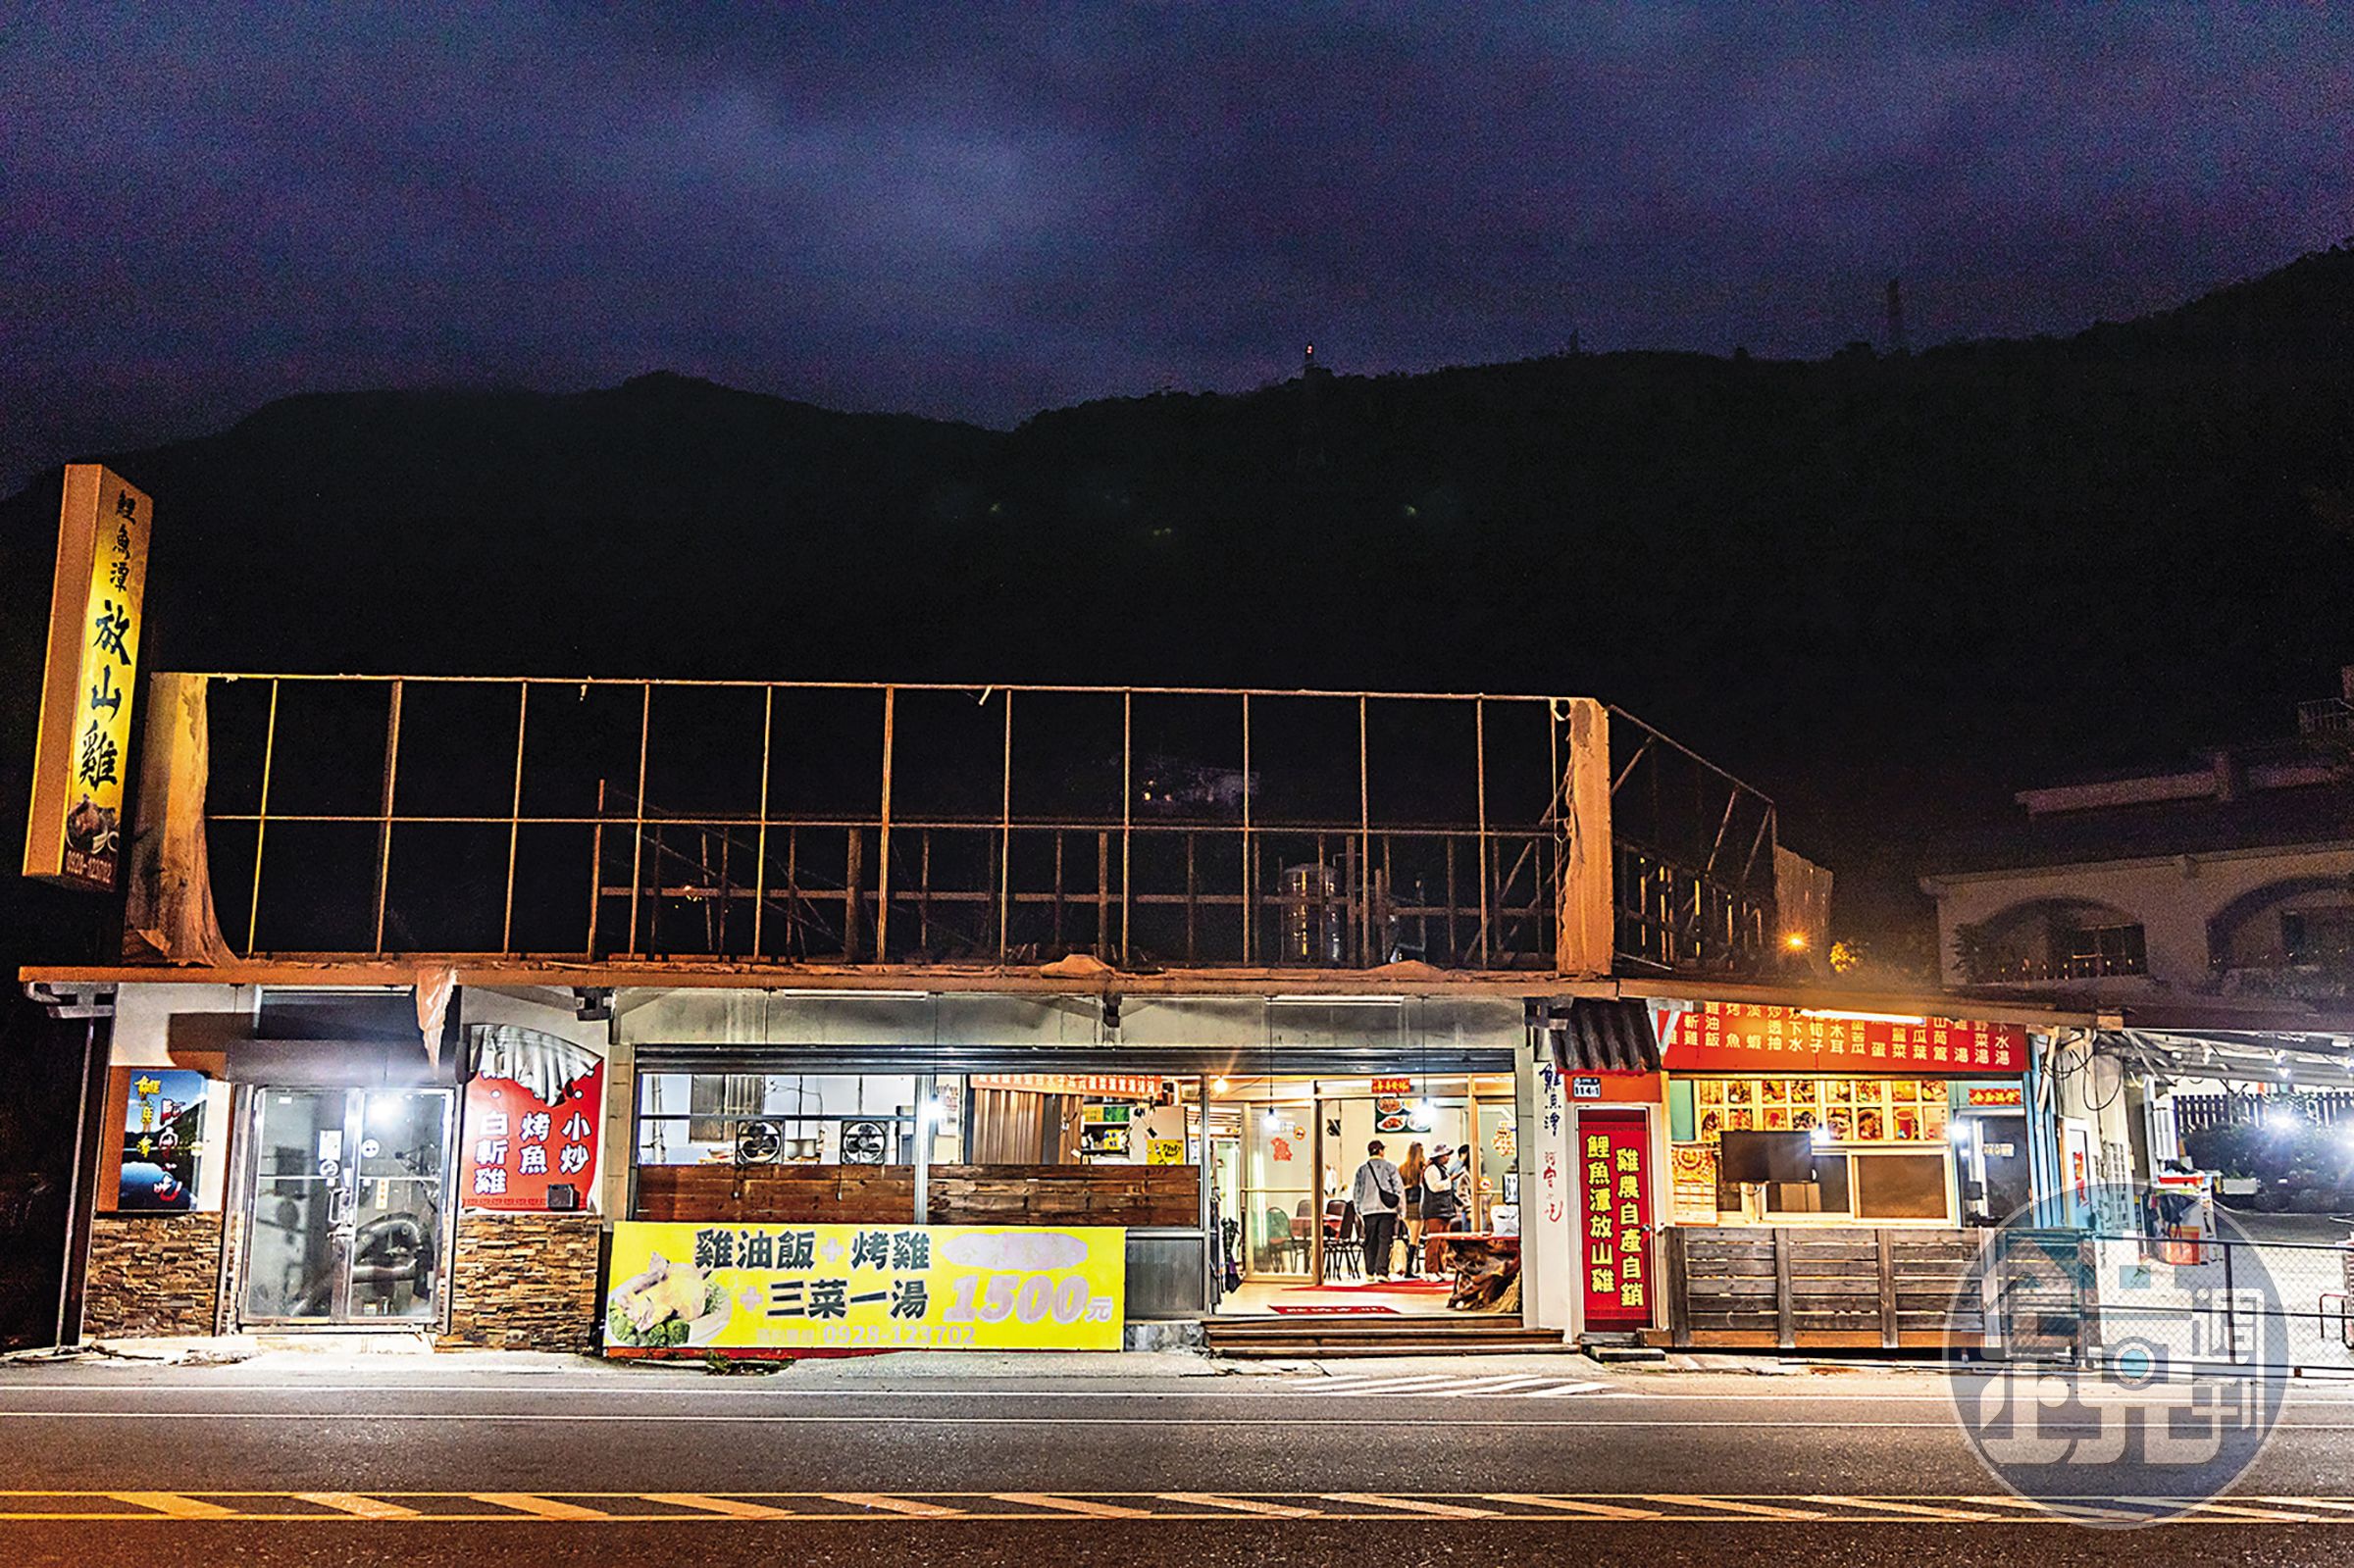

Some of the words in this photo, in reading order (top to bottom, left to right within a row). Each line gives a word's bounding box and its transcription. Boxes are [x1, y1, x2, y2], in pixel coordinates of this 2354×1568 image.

[109, 489, 137, 592] 鯉魚潭
[79, 599, 131, 792] 放山雞
[1829, 1017, 1845, 1054] 木耳
[475, 1111, 509, 1194] 白斬雞
[519, 1111, 551, 1175] 烤魚
[560, 1111, 590, 1175] 小炒
[1586, 1135, 1614, 1293] 鯉魚潭放山雞
[1615, 1148, 1644, 1307] 雞農自產自銷
[822, 1325, 976, 1344] 0928-123702
